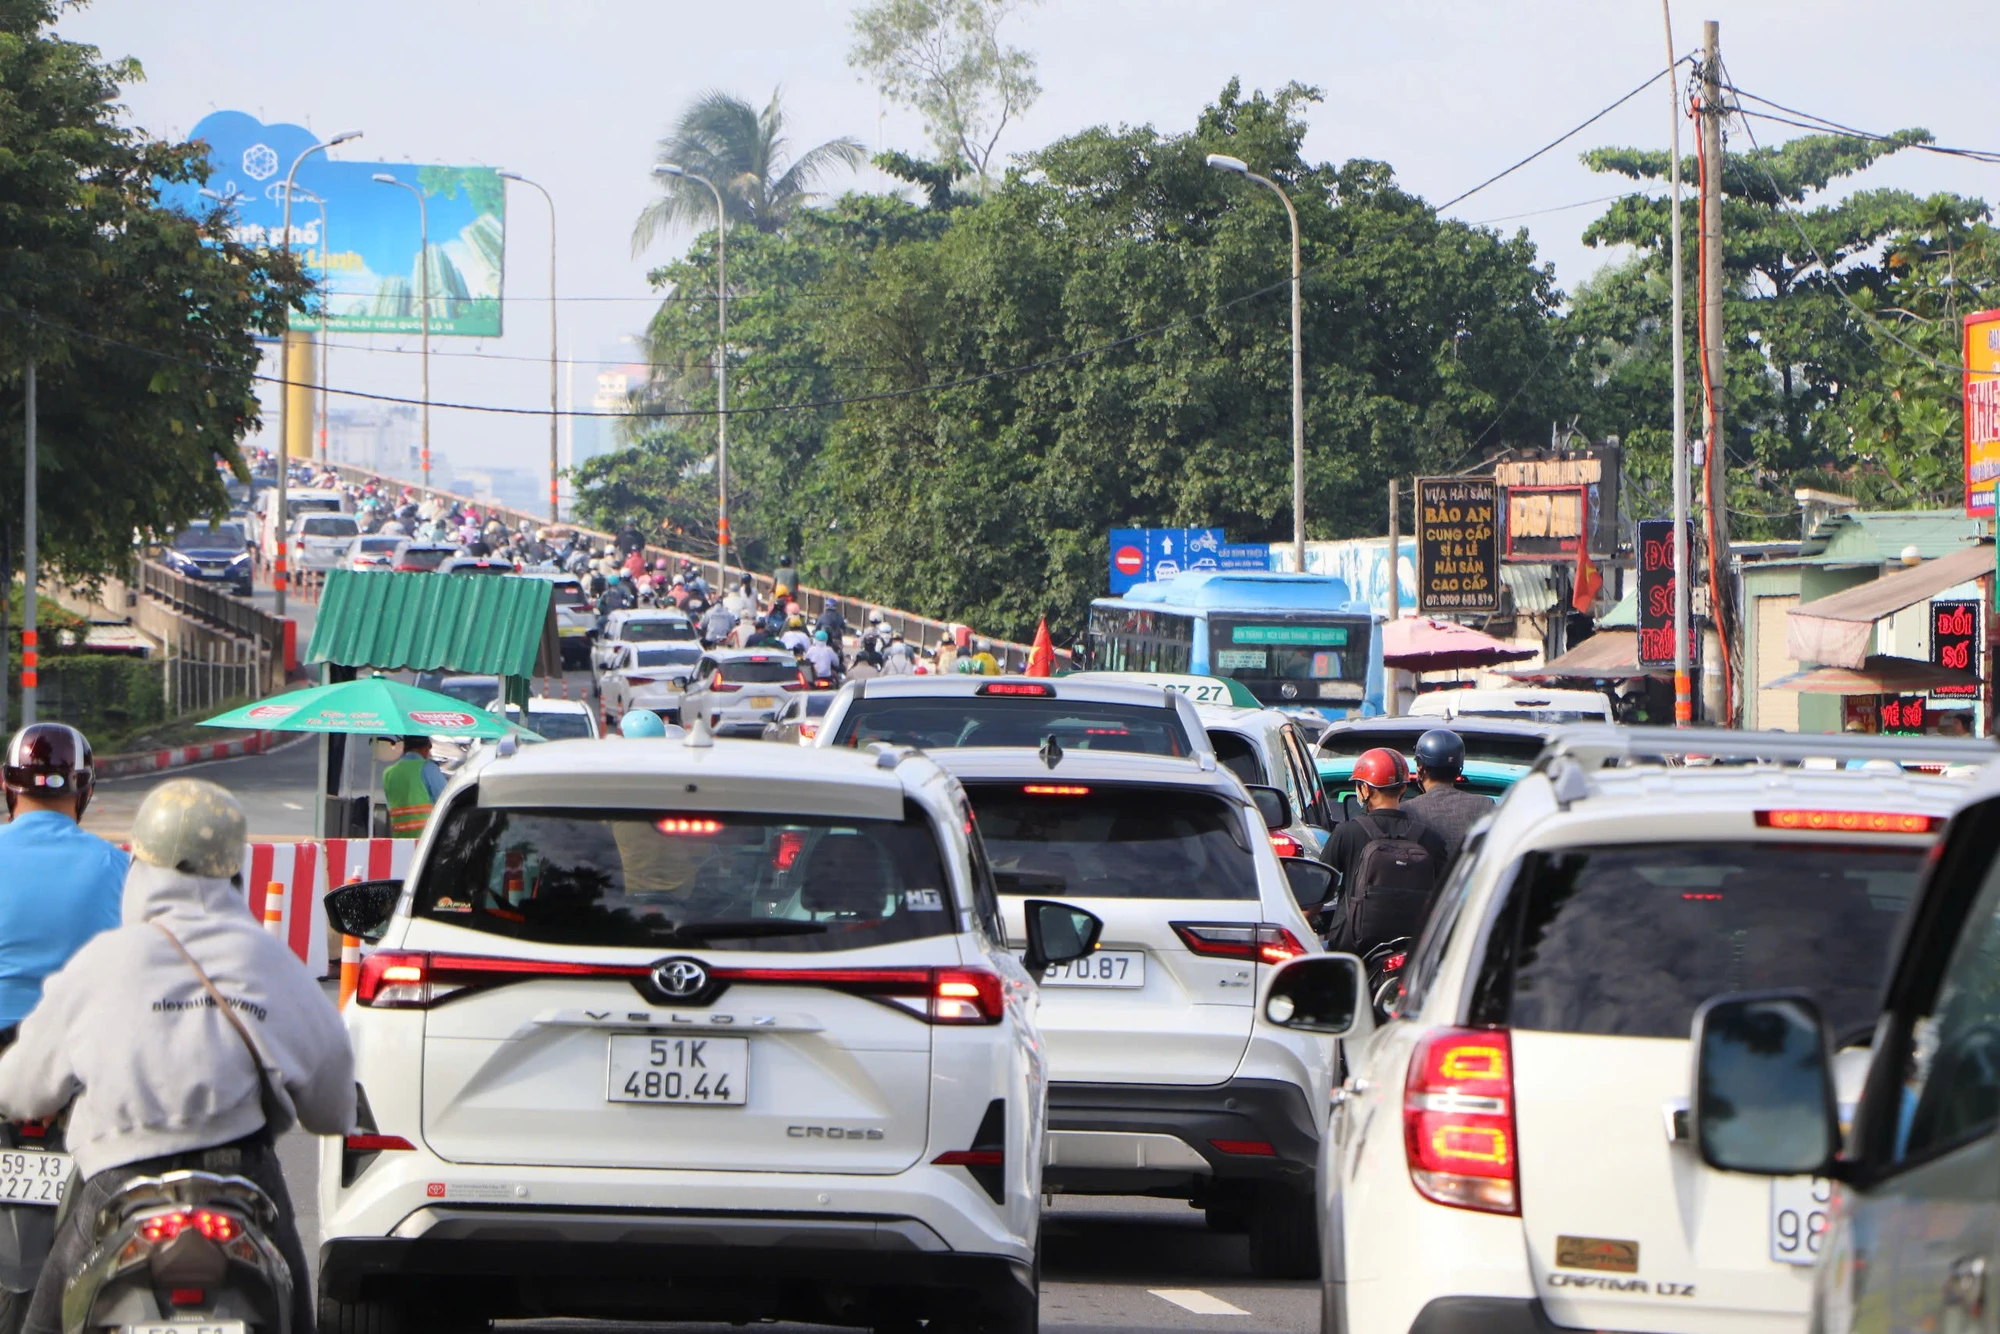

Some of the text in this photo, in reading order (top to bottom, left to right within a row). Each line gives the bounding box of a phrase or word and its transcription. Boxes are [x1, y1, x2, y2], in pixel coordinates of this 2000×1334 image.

[1465, 506, 1491, 523] AN
[1426, 523, 1492, 541] CUNG CẤP
[1453, 545, 1463, 556] &
[1435, 556, 1484, 574] HẢI SẢN
[1431, 573, 1488, 591] CAO CẤP
[1942, 640, 1969, 669] SỐ
[1196, 685, 1223, 701] 27
[1902, 698, 1923, 727] SỐ
[584, 1010, 776, 1026] VELOZ
[650, 1039, 707, 1068] 51K
[624, 1071, 731, 1100] 480.44
[786, 1125, 884, 1141] CROSS
[1548, 1273, 1696, 1297] CAPTIVA LTZ
